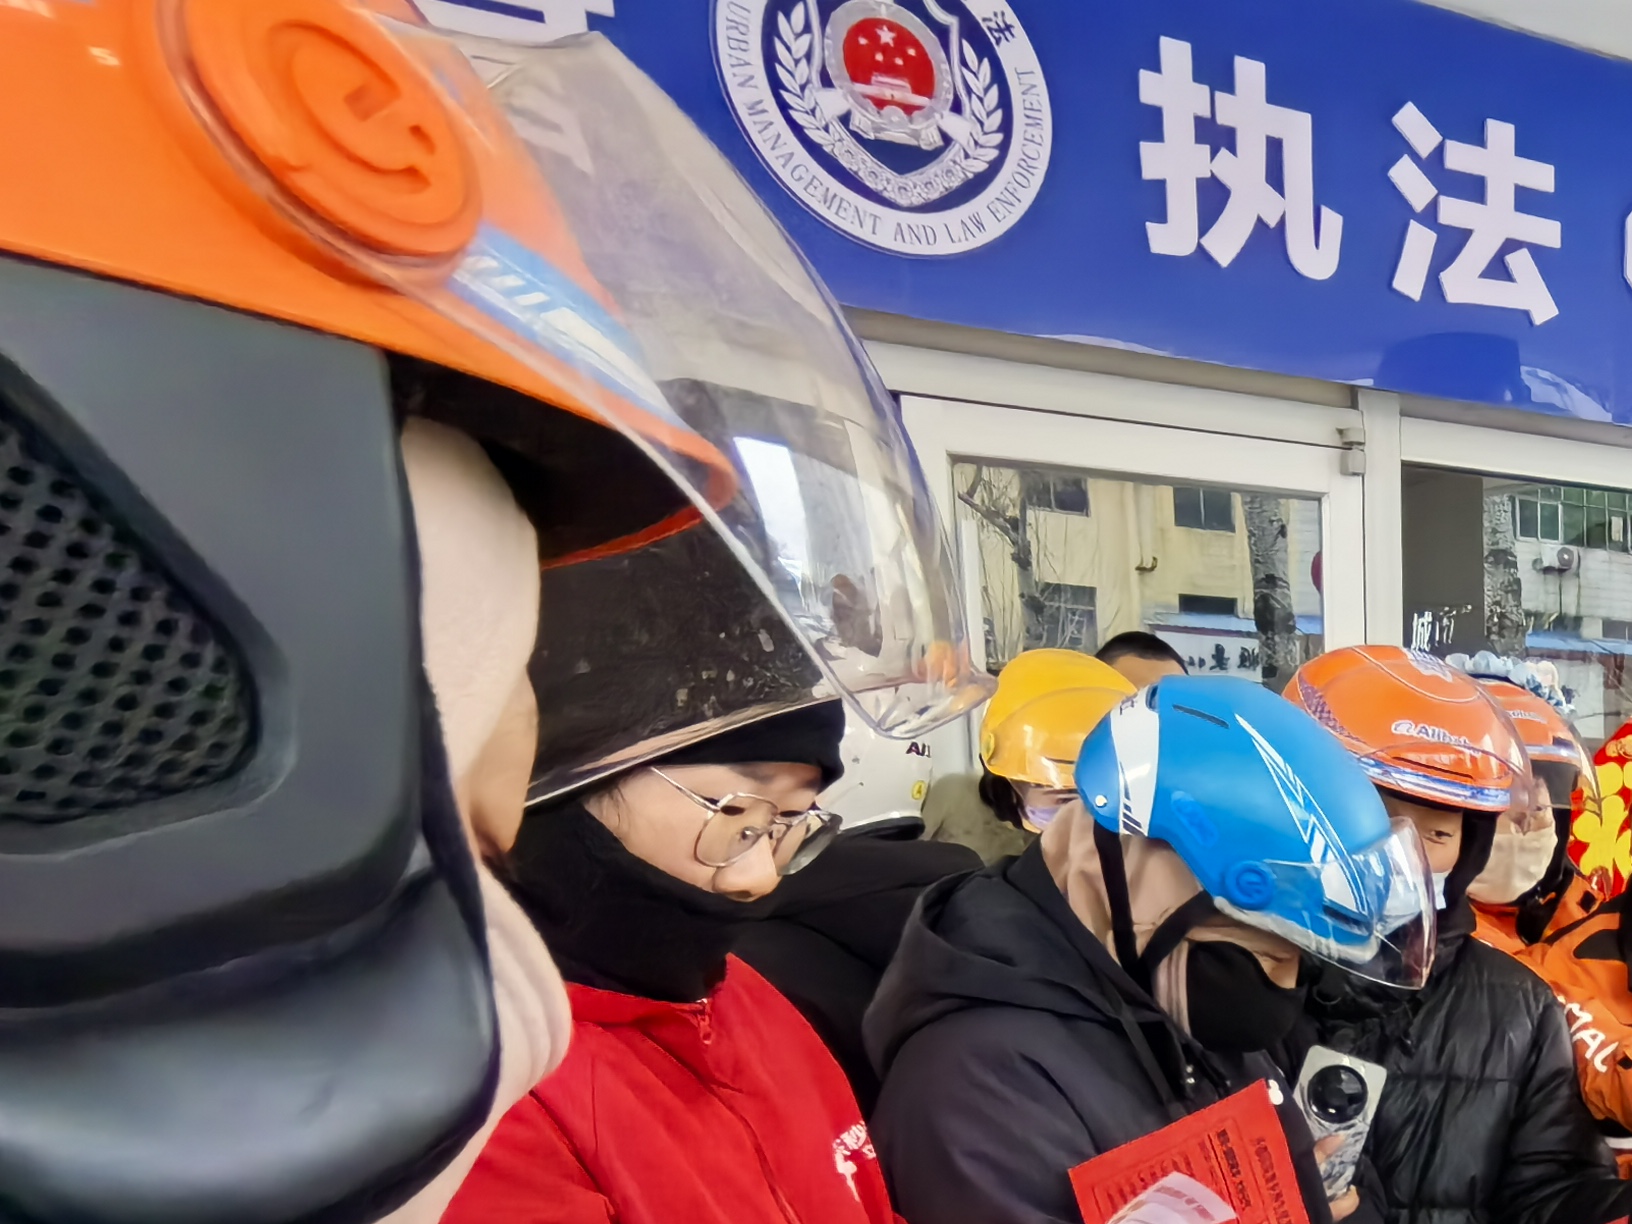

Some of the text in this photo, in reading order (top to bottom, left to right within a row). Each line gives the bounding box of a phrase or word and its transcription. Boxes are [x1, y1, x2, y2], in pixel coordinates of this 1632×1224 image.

[725, 5, 1038, 248] URBAN MANAGEMENT AND LAW ENFORCEMENT
[1138, 35, 1562, 327] 执法
